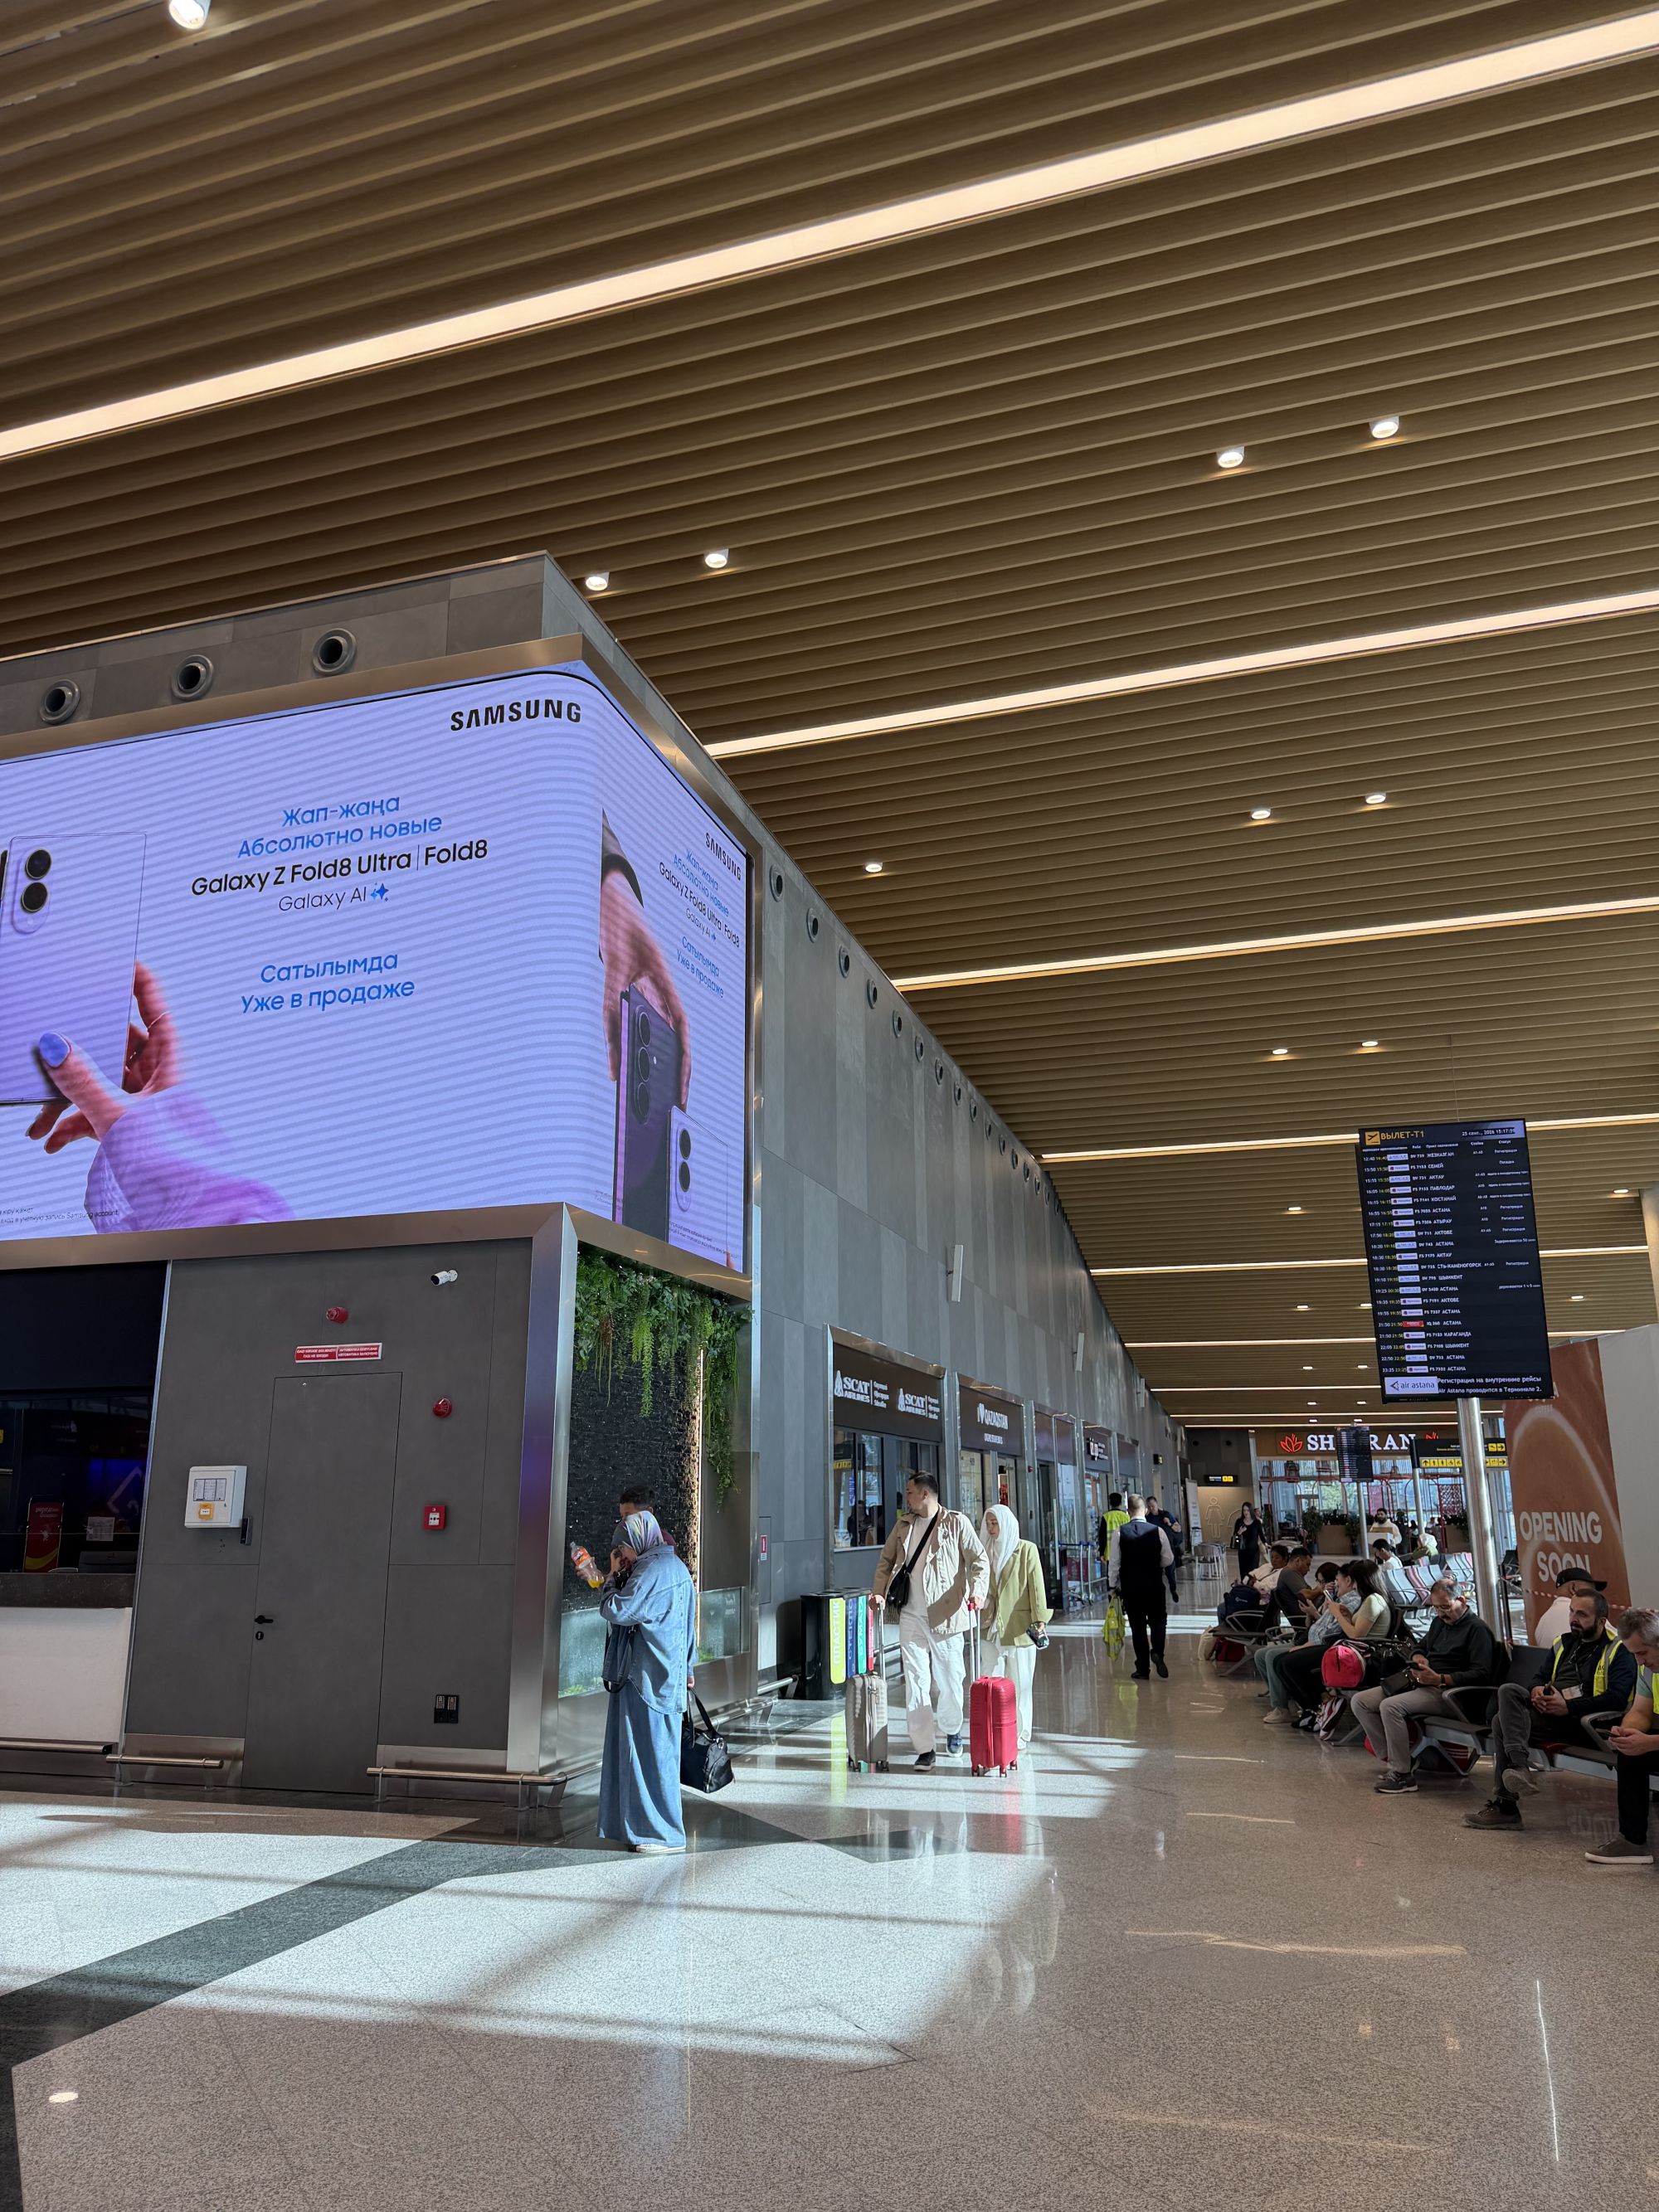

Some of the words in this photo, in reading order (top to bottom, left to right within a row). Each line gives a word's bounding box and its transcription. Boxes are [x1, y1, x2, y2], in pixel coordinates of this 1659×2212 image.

[450, 698, 581, 732] SAMSUNG
[281, 796, 400, 828] Жап-жаңа
[238, 827, 363, 859] Абсолютно
[369, 815, 443, 843] новые
[192, 868, 270, 896] Galaxy
[273, 867, 286, 886] Z
[289, 858, 352, 884] Fold8
[358, 851, 411, 876] Ultra
[424, 839, 488, 867] Fold8
[705, 832, 742, 881] SAMSUNG
[279, 887, 346, 912] Galaxy
[350, 887, 367, 903] AI
[674, 853, 709, 897] Абсолютно
[710, 893, 729, 917] новые
[659, 862, 684, 897] Galaxy
[684, 887, 688, 899] Z
[689, 890, 707, 916] Fold8
[707, 907, 722, 931] Ultra
[724, 923, 740, 948] Fold8
[686, 907, 705, 936] Galaxy
[260, 954, 398, 984] Сатылымда
[682, 936, 719, 977] Сатылымда
[677, 949, 690, 970] Уже
[690, 963, 695, 974] в
[696, 968, 724, 998] продаже
[241, 992, 285, 1014] Уже
[290, 993, 302, 1008] в
[308, 979, 415, 1011] продаже
[1380, 1130, 1424, 1140] ВЫЛЕТ-Т1
[66, 1212, 93, 1220] Samsung
[843, 1377, 870, 1395] SCAT
[1437, 1376, 1474, 1384] Регистрация
[843, 1391, 870, 1403] AIRLINES
[904, 1393, 926, 1408] SCAT
[904, 1405, 926, 1417] AIRLINES
[985, 1409, 1008, 1430] QAZAQSTAN
[1520, 1510, 1602, 1544] OPENING
